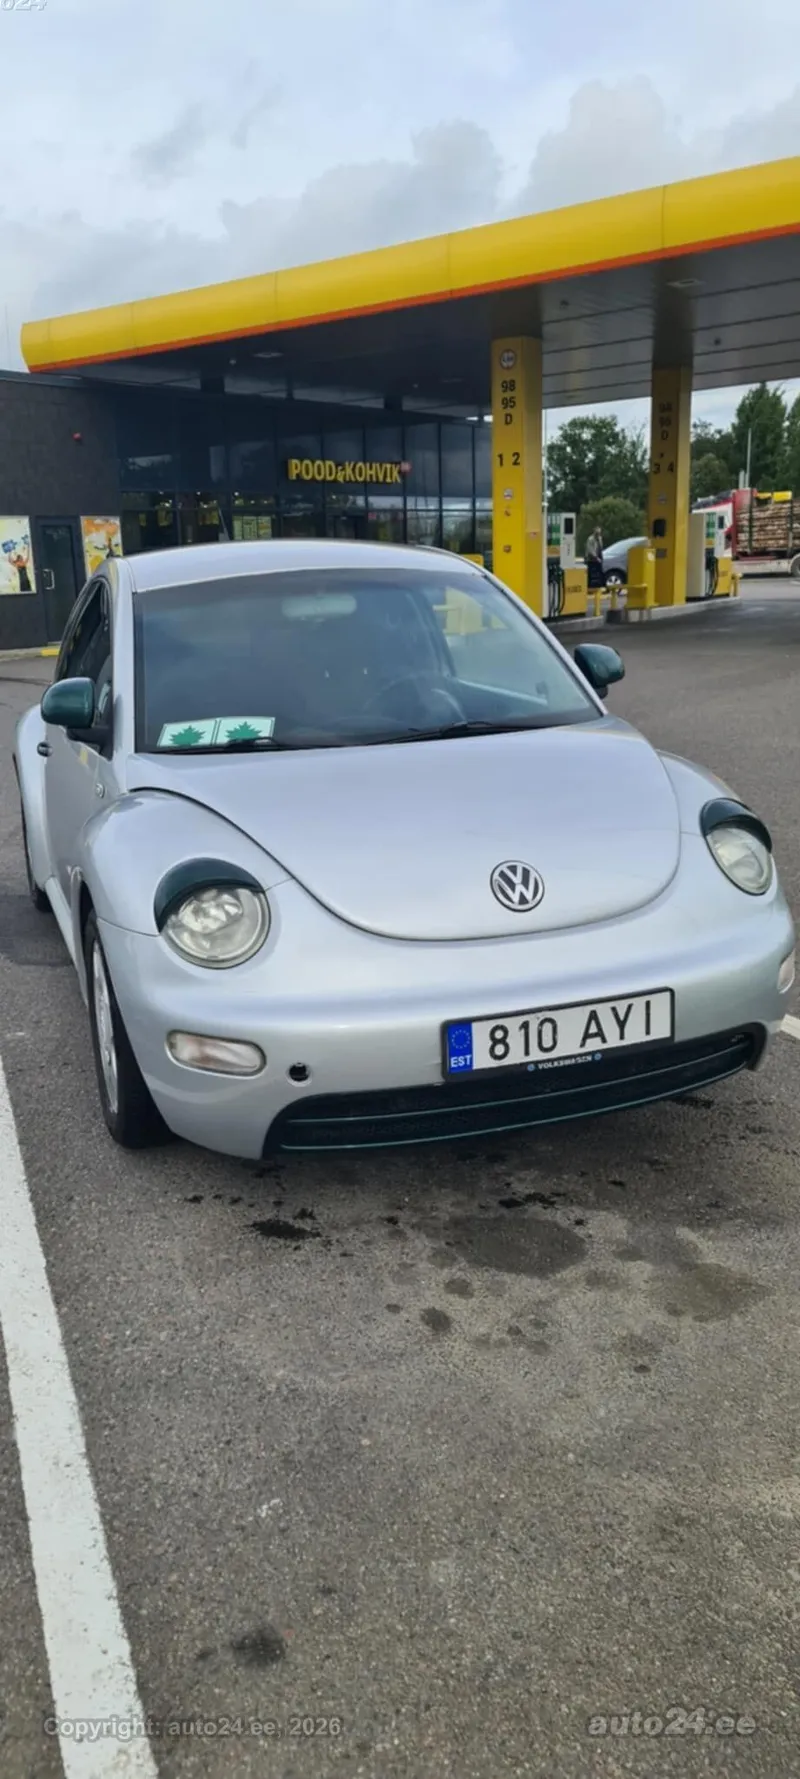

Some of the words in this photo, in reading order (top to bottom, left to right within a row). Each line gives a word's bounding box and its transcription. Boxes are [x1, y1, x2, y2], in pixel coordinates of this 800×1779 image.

[501, 379, 516, 393] 98
[501, 396, 516, 409] 95
[504, 412, 513, 425] D
[497, 453, 503, 467] 1
[512, 452, 520, 466] 2
[288, 459, 402, 483] POOD&KOHVIK
[652, 463, 660, 474] 3
[667, 461, 675, 472] 4
[489, 1017, 558, 1061] 810
[579, 1000, 651, 1048] AYI
[450, 1055, 472, 1068] EST
